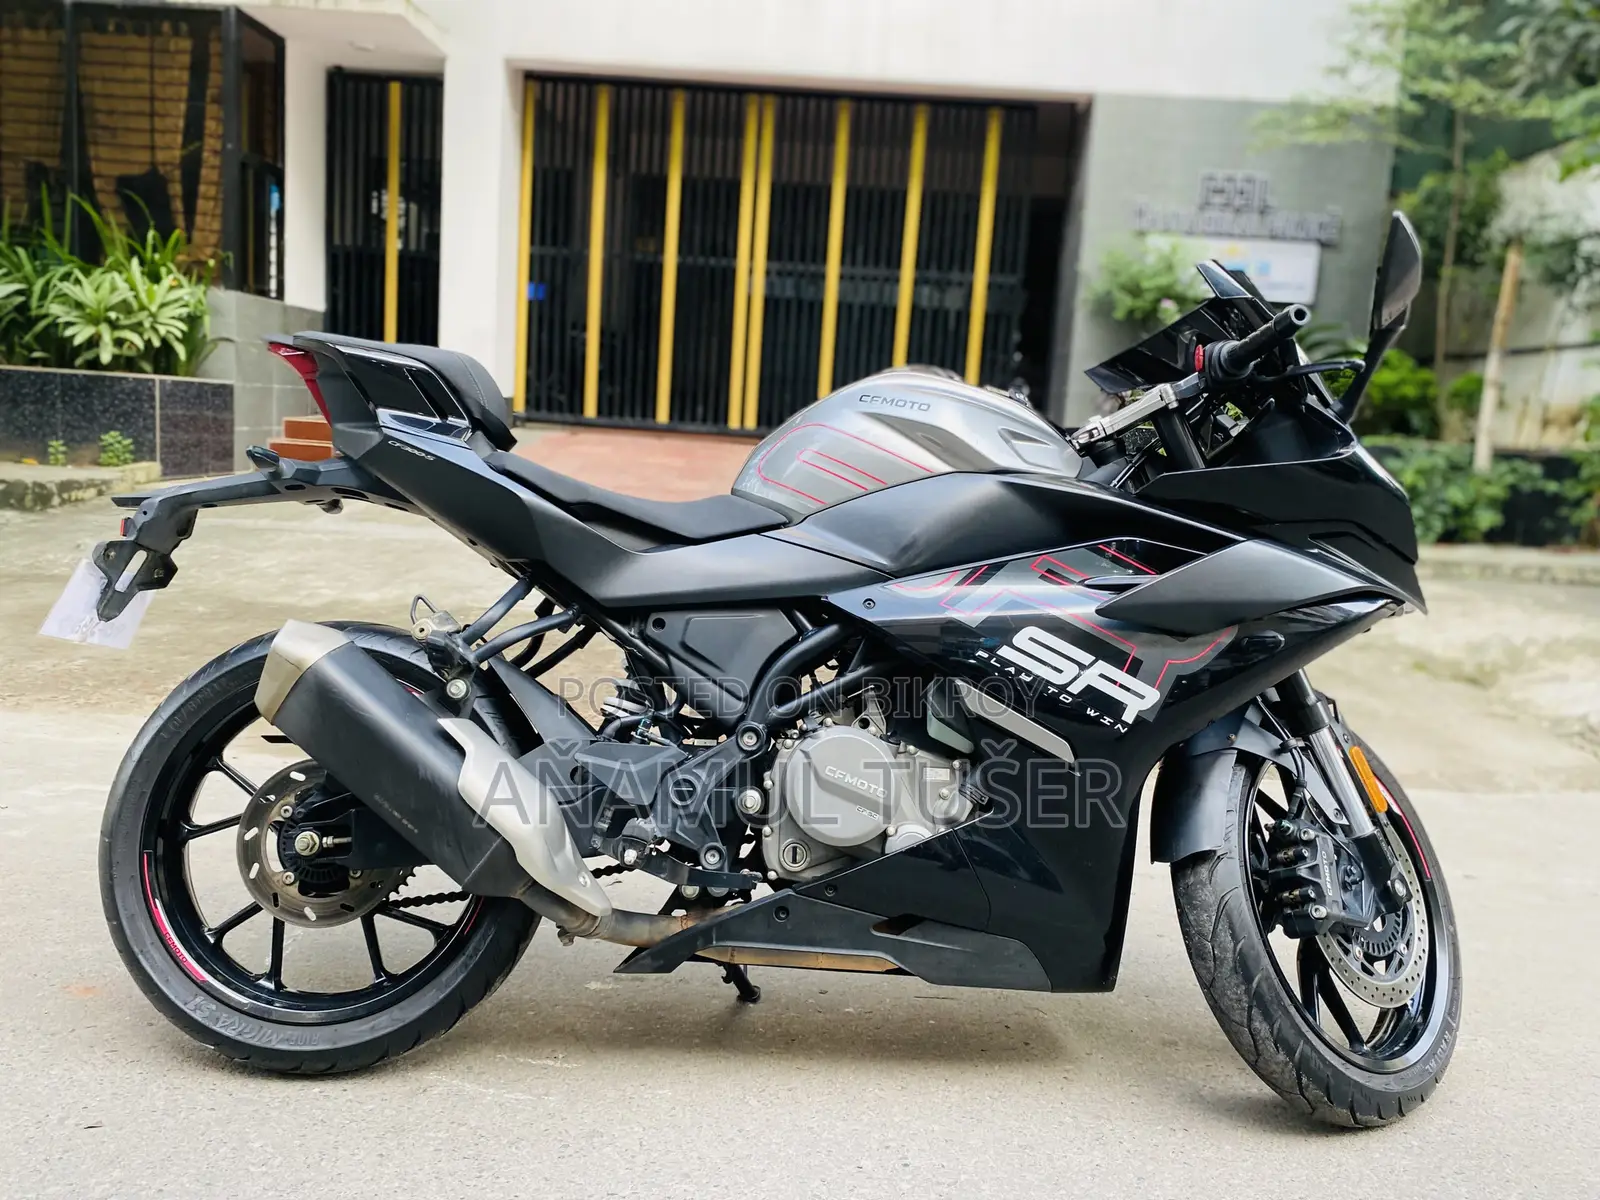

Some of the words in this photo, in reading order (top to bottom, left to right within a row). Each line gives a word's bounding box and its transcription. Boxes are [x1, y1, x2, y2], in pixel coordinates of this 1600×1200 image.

[859, 394, 931, 412] CFMOTO
[975, 650, 1034, 682] PLAY
[1047, 685, 1074, 704] TO
[1086, 707, 1128, 734] WIN
[996, 626, 1160, 724] SR
[825, 765, 888, 799] CFMOTO
[1321, 850, 1333, 896] CFMOTO
[164, 931, 188, 963] CFMOTO
